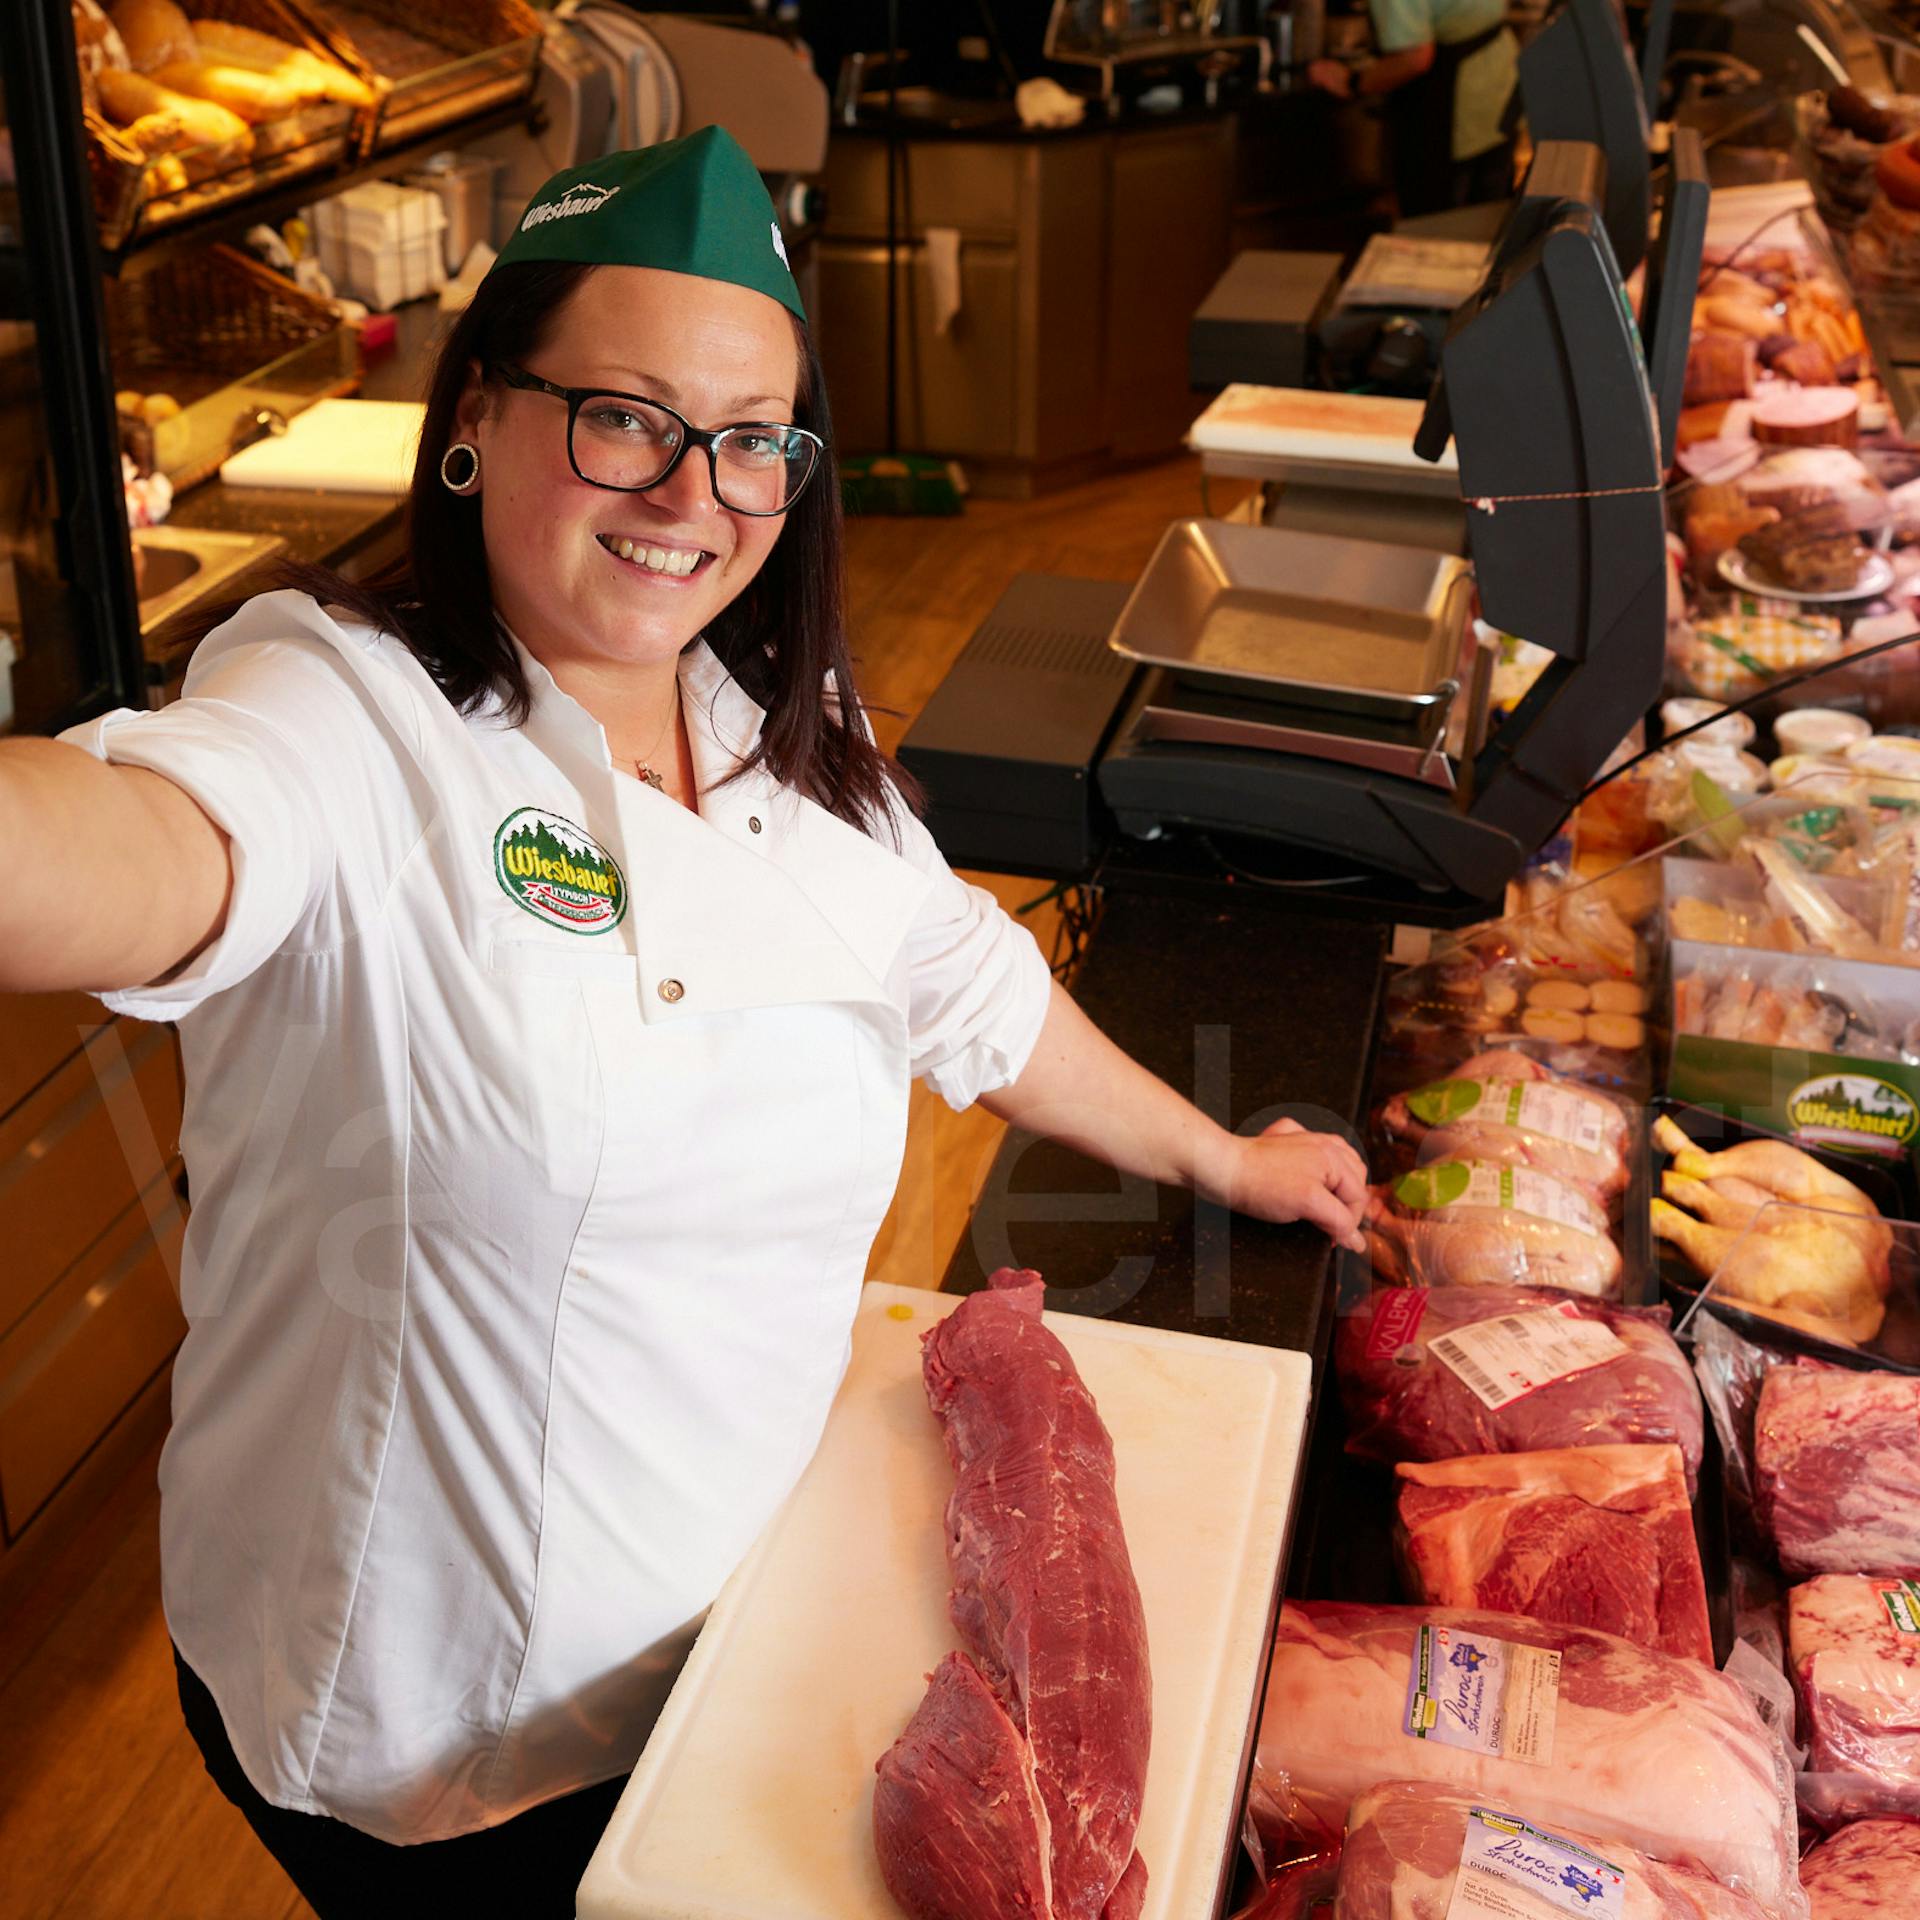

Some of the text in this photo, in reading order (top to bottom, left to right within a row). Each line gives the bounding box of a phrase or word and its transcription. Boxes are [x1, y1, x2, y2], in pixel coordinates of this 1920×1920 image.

[521, 186, 621, 232] Wiesbauer
[505, 844, 617, 896] Wiesbauer
[1795, 1101, 1910, 1138] Wiesbauer
[1443, 1674, 1472, 1726] Duroc
[1468, 1675, 1485, 1736] Strohschwein
[1489, 1717, 1502, 1749] DUROC
[1470, 1860, 1509, 1881] DUROC
[1482, 1848, 1559, 1888] Strohschwein
[1494, 1838, 1557, 1875] Duroc
